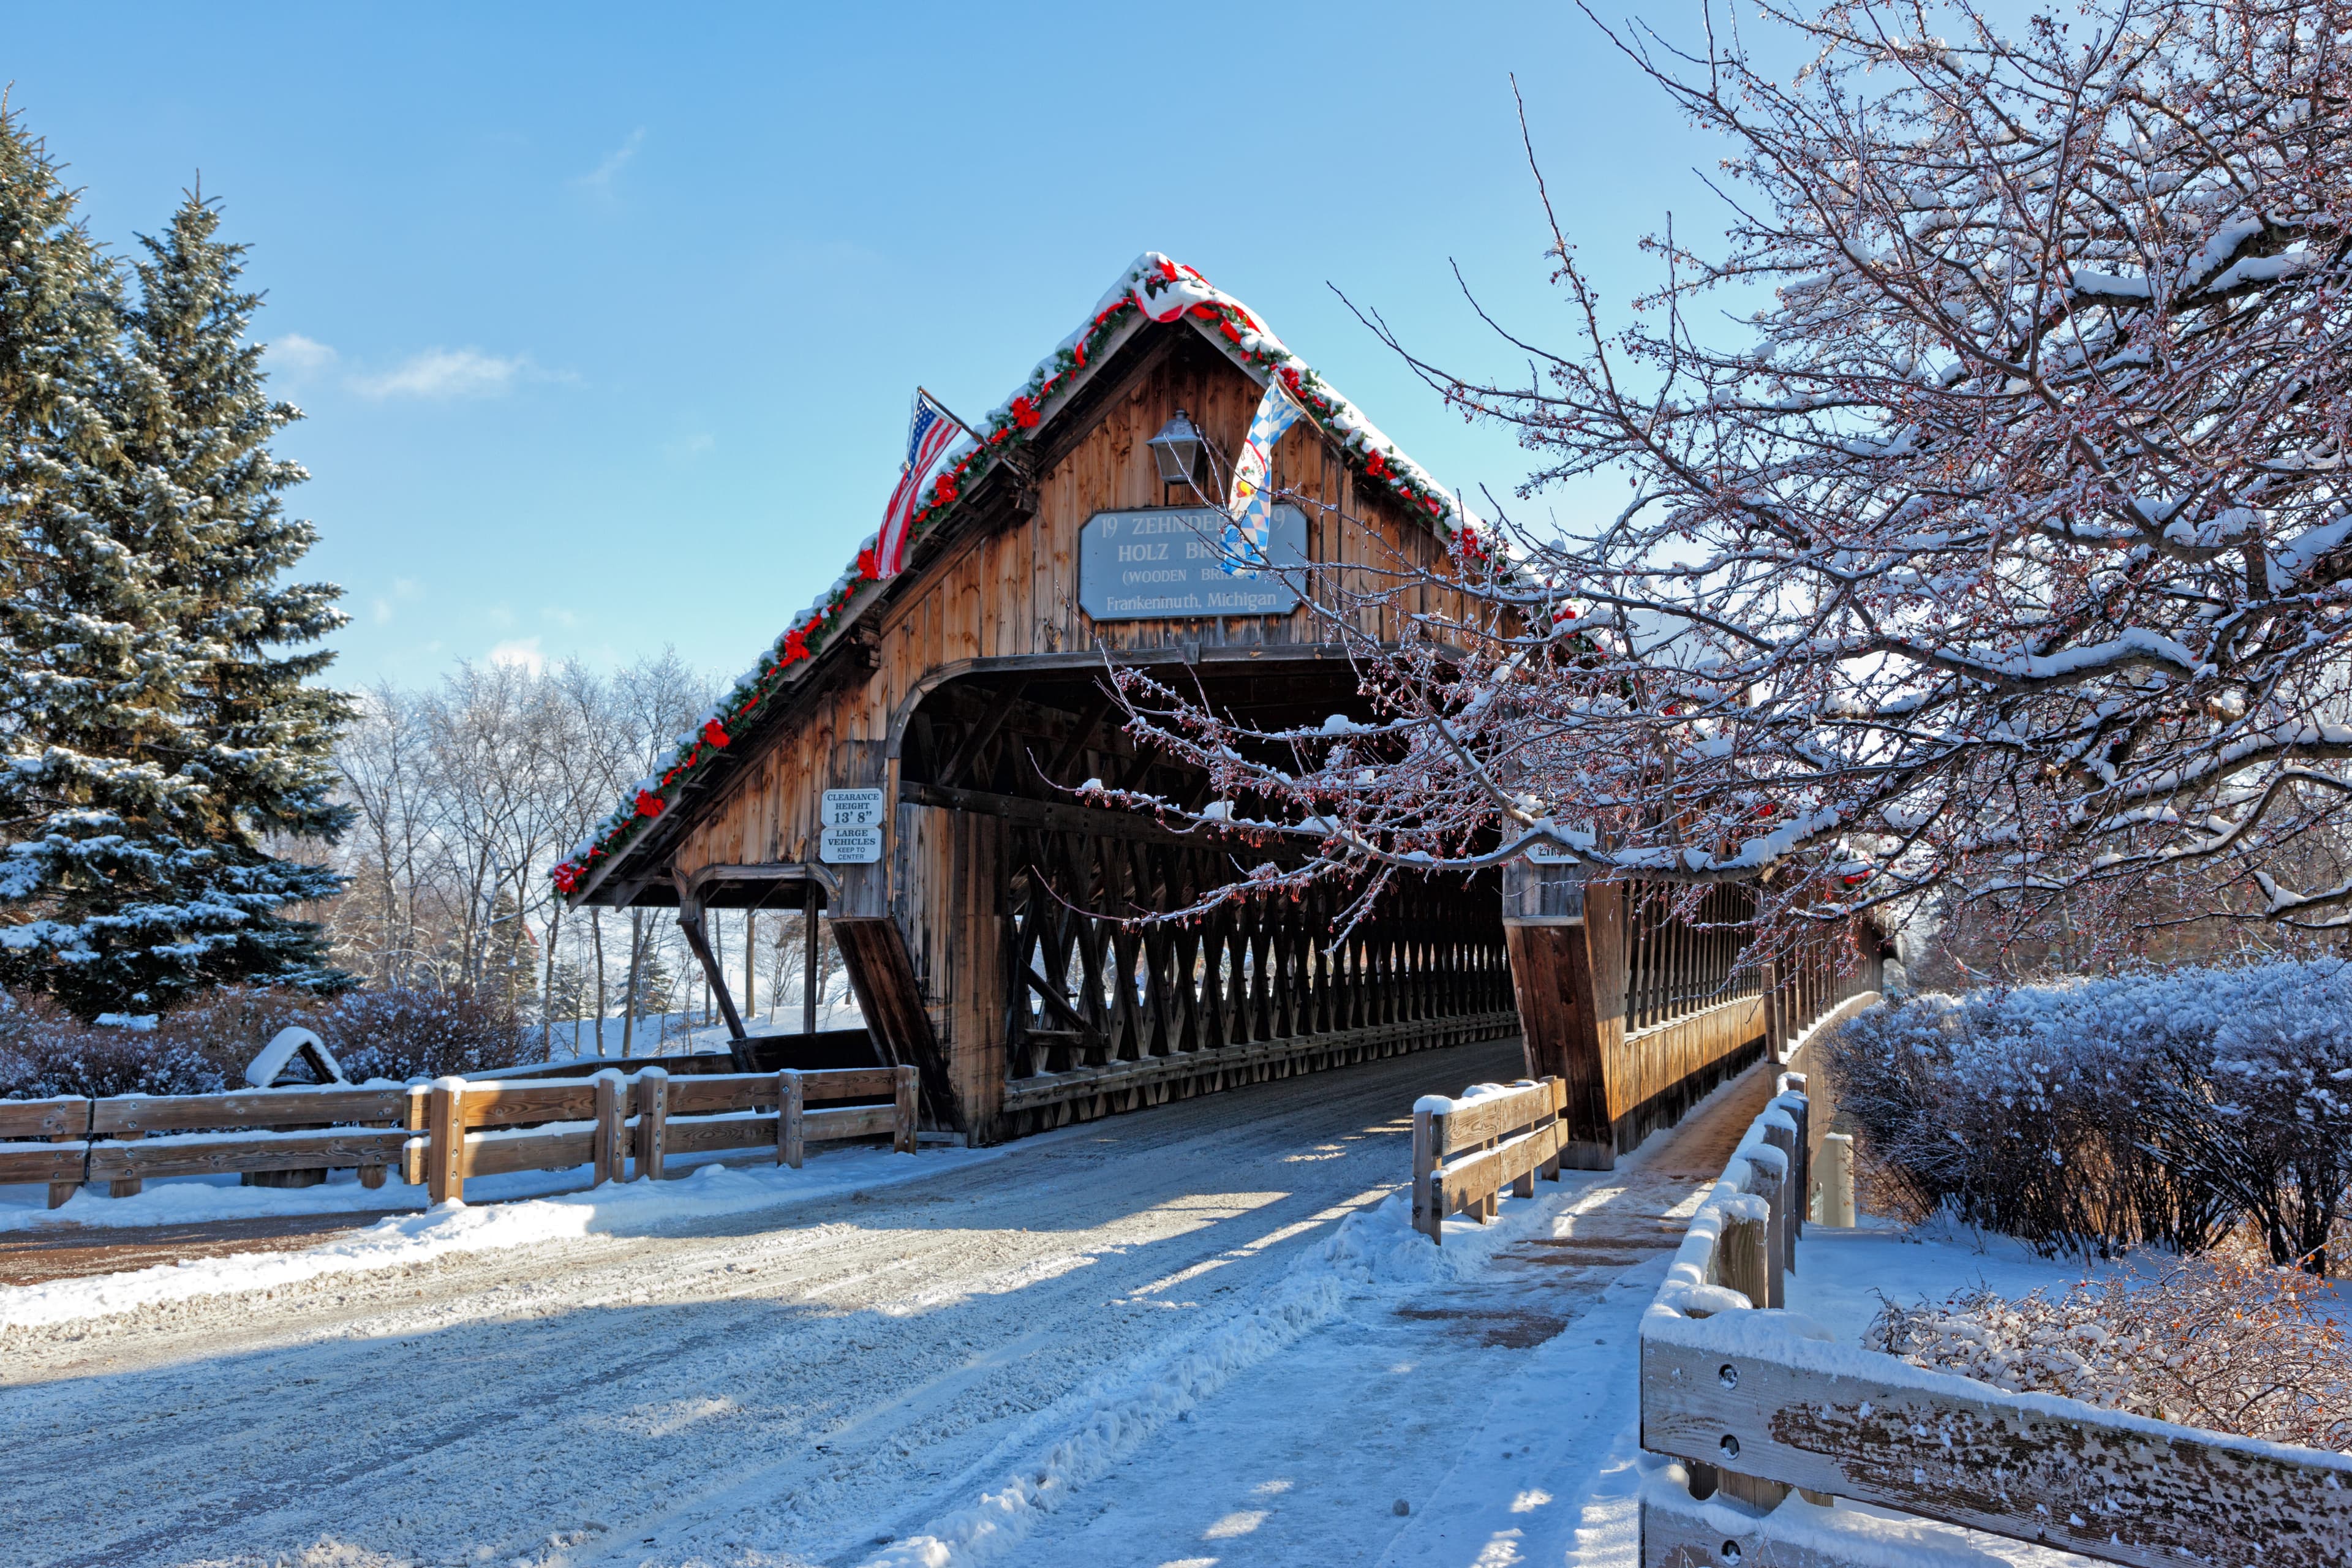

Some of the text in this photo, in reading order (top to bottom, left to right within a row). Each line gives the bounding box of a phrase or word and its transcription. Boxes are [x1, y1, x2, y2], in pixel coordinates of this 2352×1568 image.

[1118, 543, 1169, 562] HOLZ
[1122, 569, 1186, 586] (WOODEN
[1107, 592, 1276, 611] Frankenmuth, Michigan
